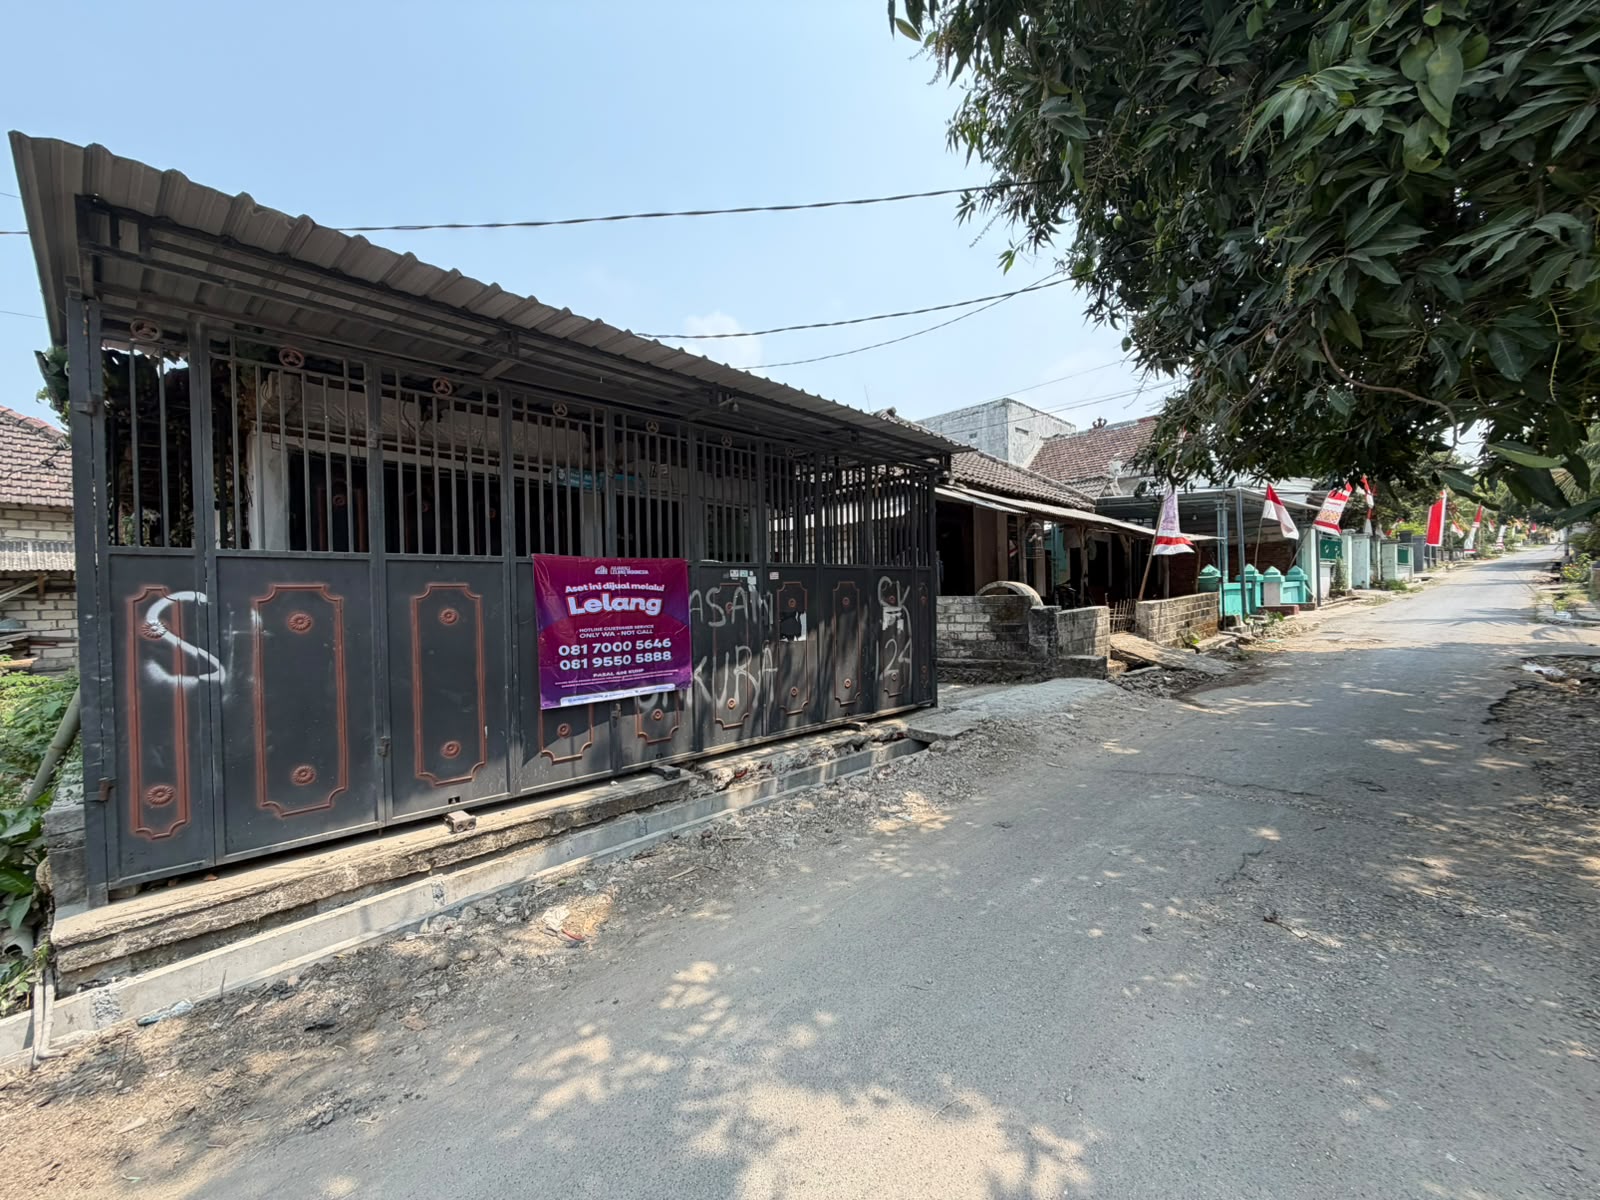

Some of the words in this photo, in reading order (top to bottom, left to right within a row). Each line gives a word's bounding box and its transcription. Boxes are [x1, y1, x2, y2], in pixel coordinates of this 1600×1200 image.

[565, 584, 588, 593] Aset
[589, 582, 602, 590] ini
[603, 582, 630, 591] dijual
[631, 583, 665, 592] melalui
[567, 592, 662, 616] Lelang
[558, 644, 588, 656] 081
[592, 641, 632, 654] 7000
[635, 638, 672, 650] 5646
[559, 658, 588, 670] 081
[592, 655, 632, 668] 9550
[635, 651, 672, 664] 5888
